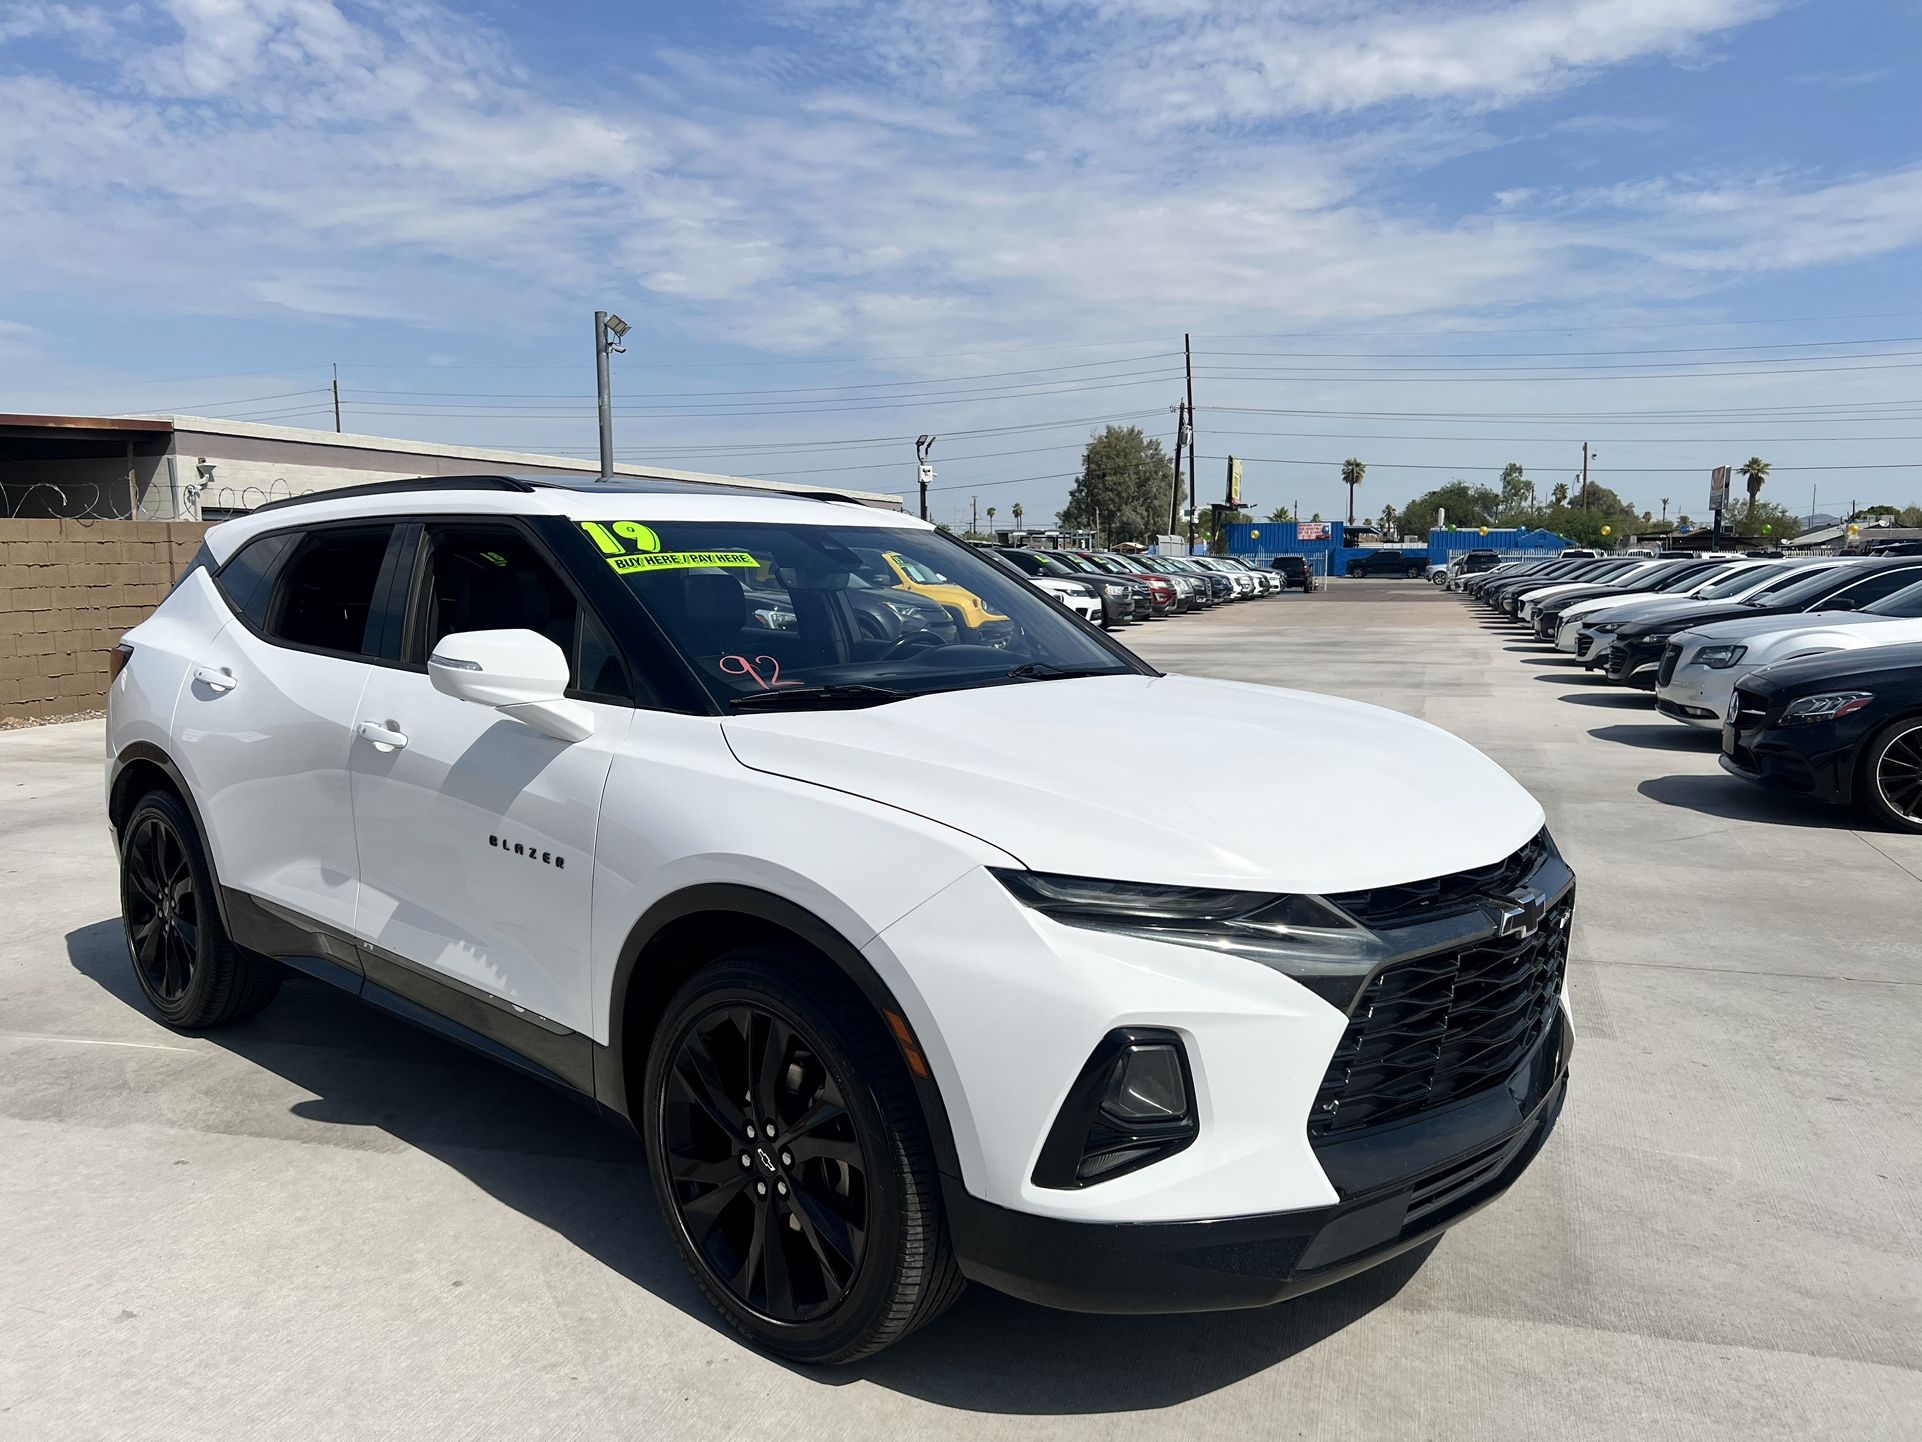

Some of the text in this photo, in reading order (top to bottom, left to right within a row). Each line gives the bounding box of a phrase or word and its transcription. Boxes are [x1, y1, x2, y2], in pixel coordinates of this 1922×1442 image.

[580, 520, 661, 555] 19
[614, 557, 642, 569] BUY
[645, 554, 680, 566] HERE
[691, 554, 714, 564] PAY
[717, 553, 750, 563] HERE
[719, 655, 805, 690] 92
[489, 835, 565, 869] BLAZER
